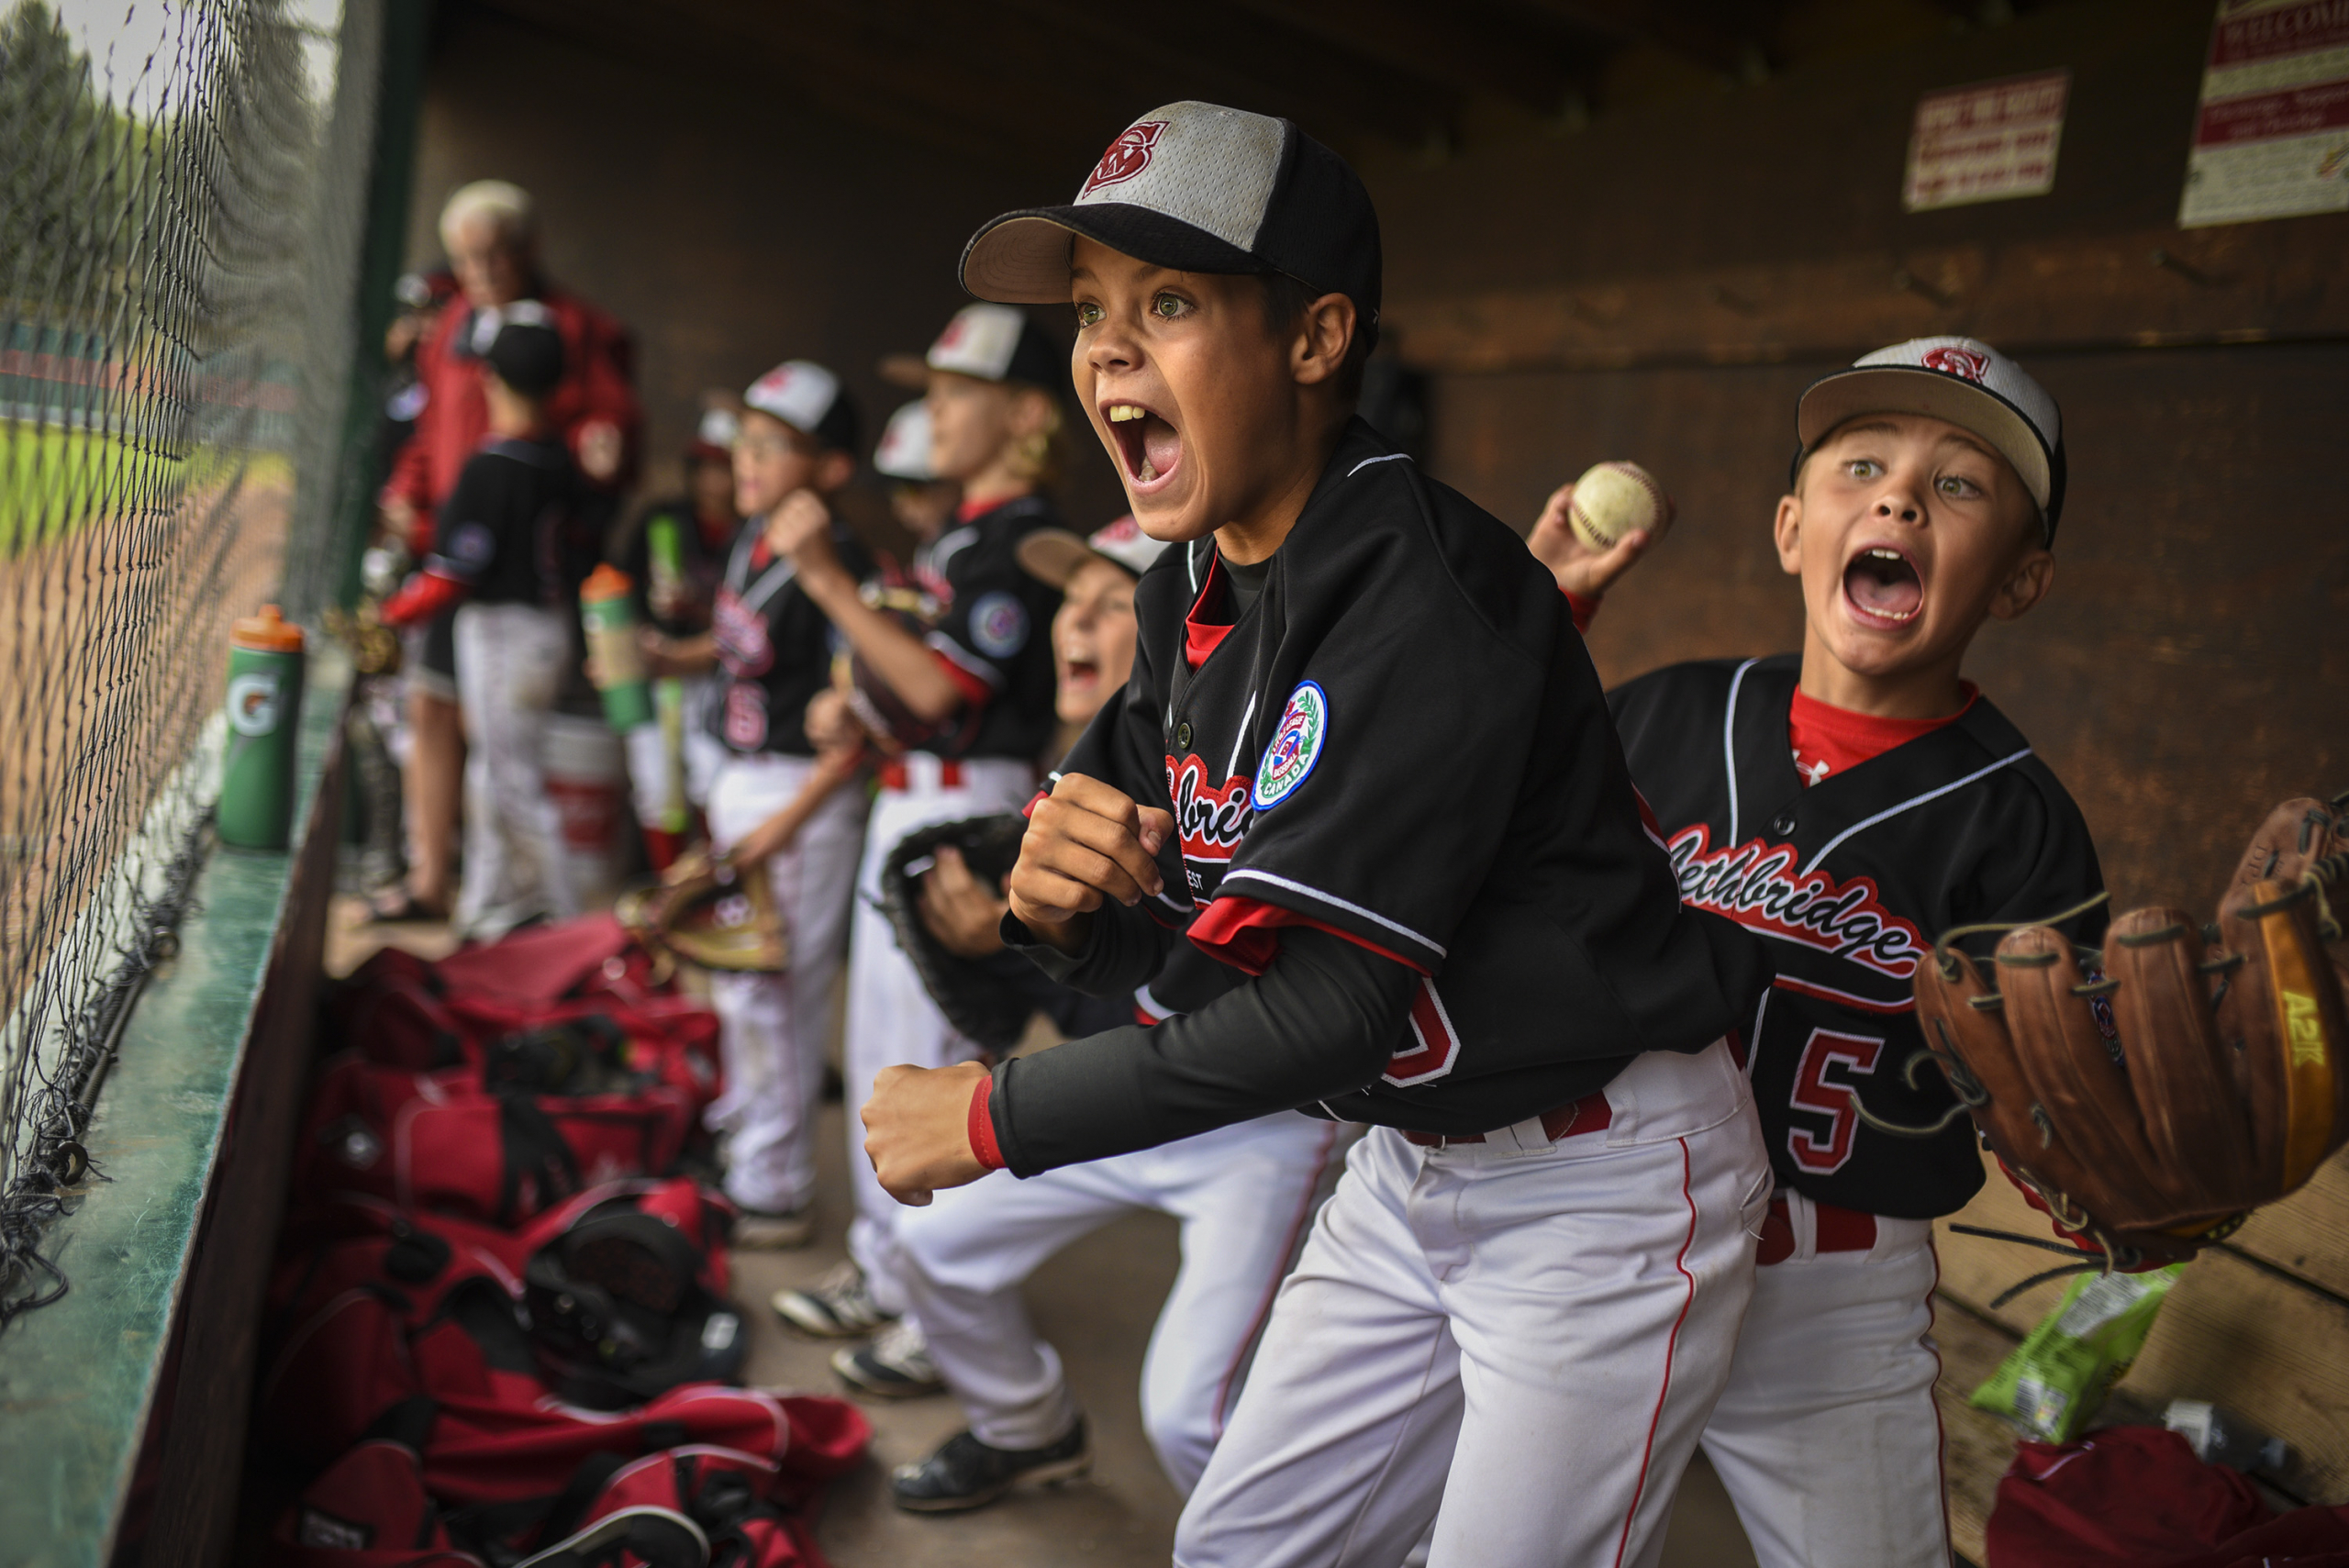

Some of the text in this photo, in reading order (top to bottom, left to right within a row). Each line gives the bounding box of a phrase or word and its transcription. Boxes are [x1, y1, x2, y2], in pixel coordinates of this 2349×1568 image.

[228, 673, 279, 738] G
[1264, 753, 1310, 796] CANADA
[2282, 990, 2326, 1068] A2K
[1787, 1027, 1886, 1176] 5
